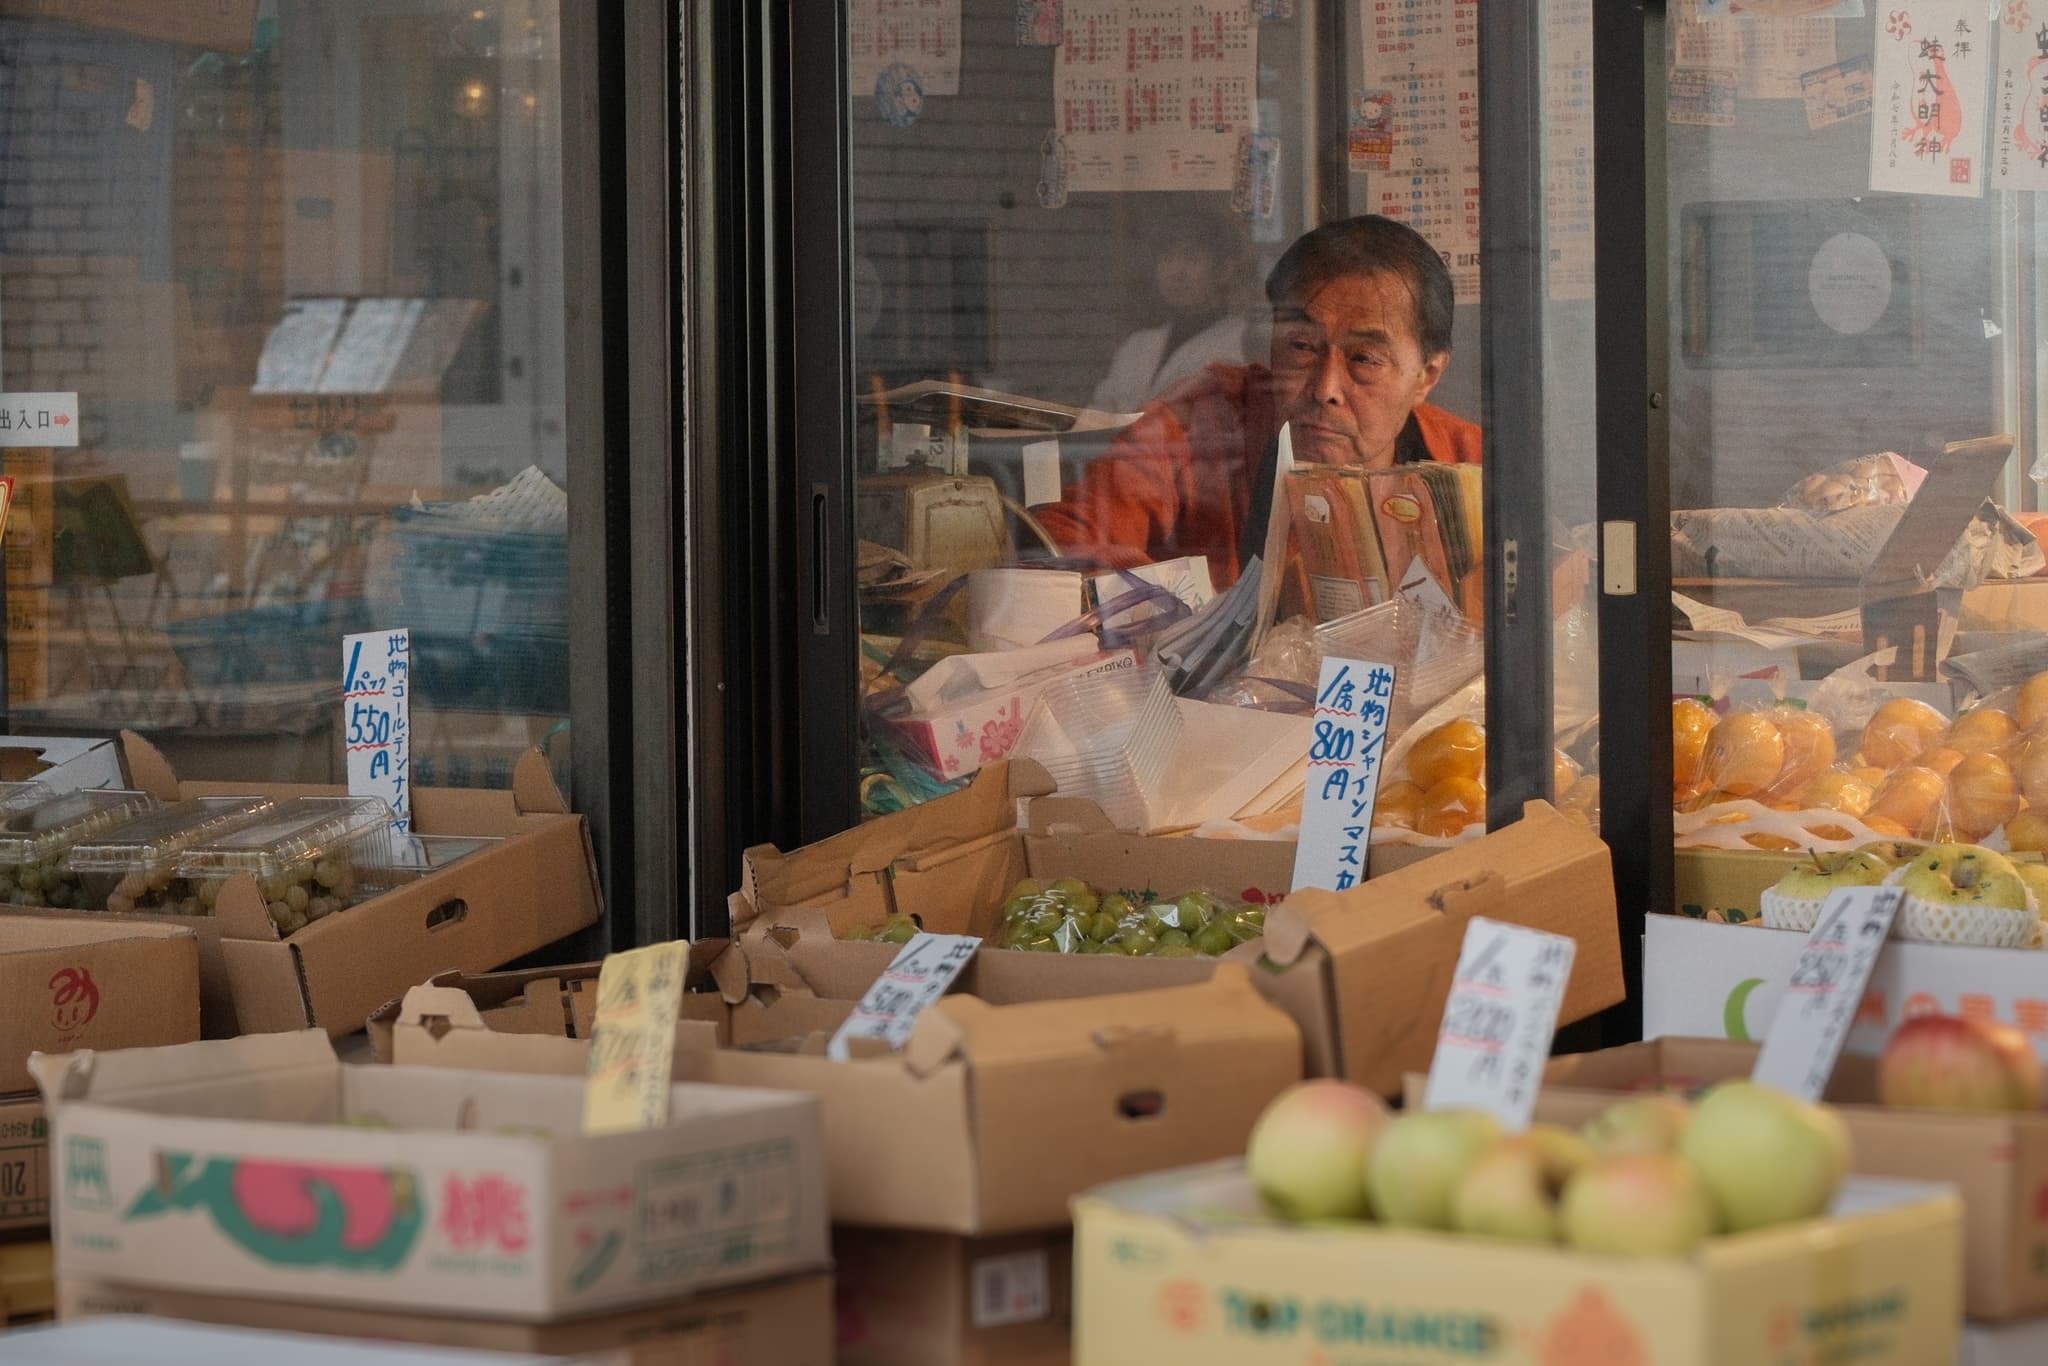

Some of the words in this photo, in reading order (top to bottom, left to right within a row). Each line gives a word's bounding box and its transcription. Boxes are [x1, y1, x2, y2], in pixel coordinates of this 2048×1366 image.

[1914, 36, 1946, 164] 蛙大明神
[1411, 158, 1423, 167] 10
[0, 408, 49, 429] 出入口
[347, 702, 390, 744] 550
[1309, 720, 1354, 761] 800
